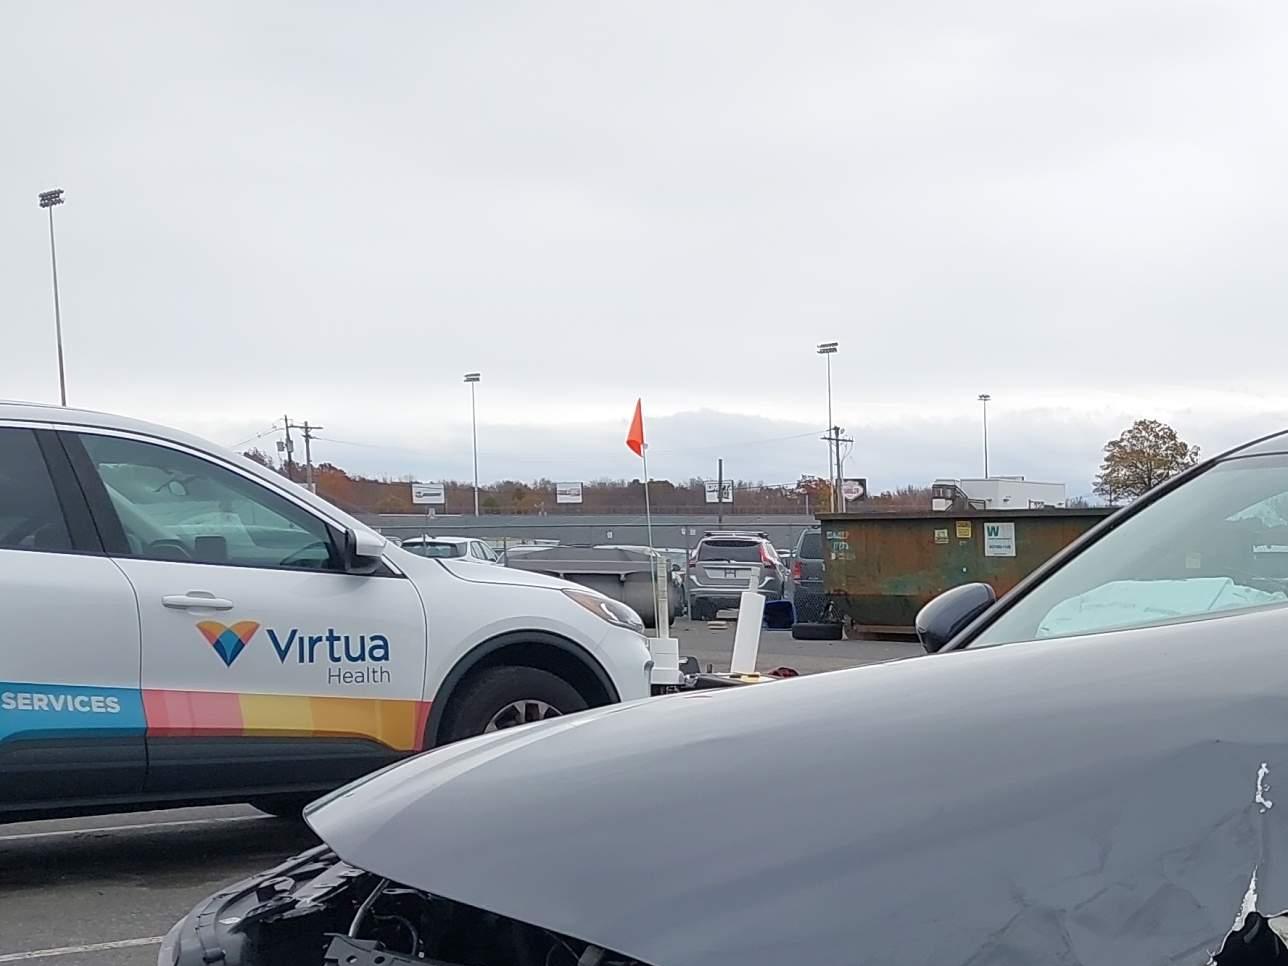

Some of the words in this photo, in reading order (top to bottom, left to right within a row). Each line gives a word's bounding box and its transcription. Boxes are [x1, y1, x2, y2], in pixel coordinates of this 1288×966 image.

[266, 628, 390, 664] Virtua
[327, 666, 391, 685] Health
[1, 691, 121, 713] SERVICES
